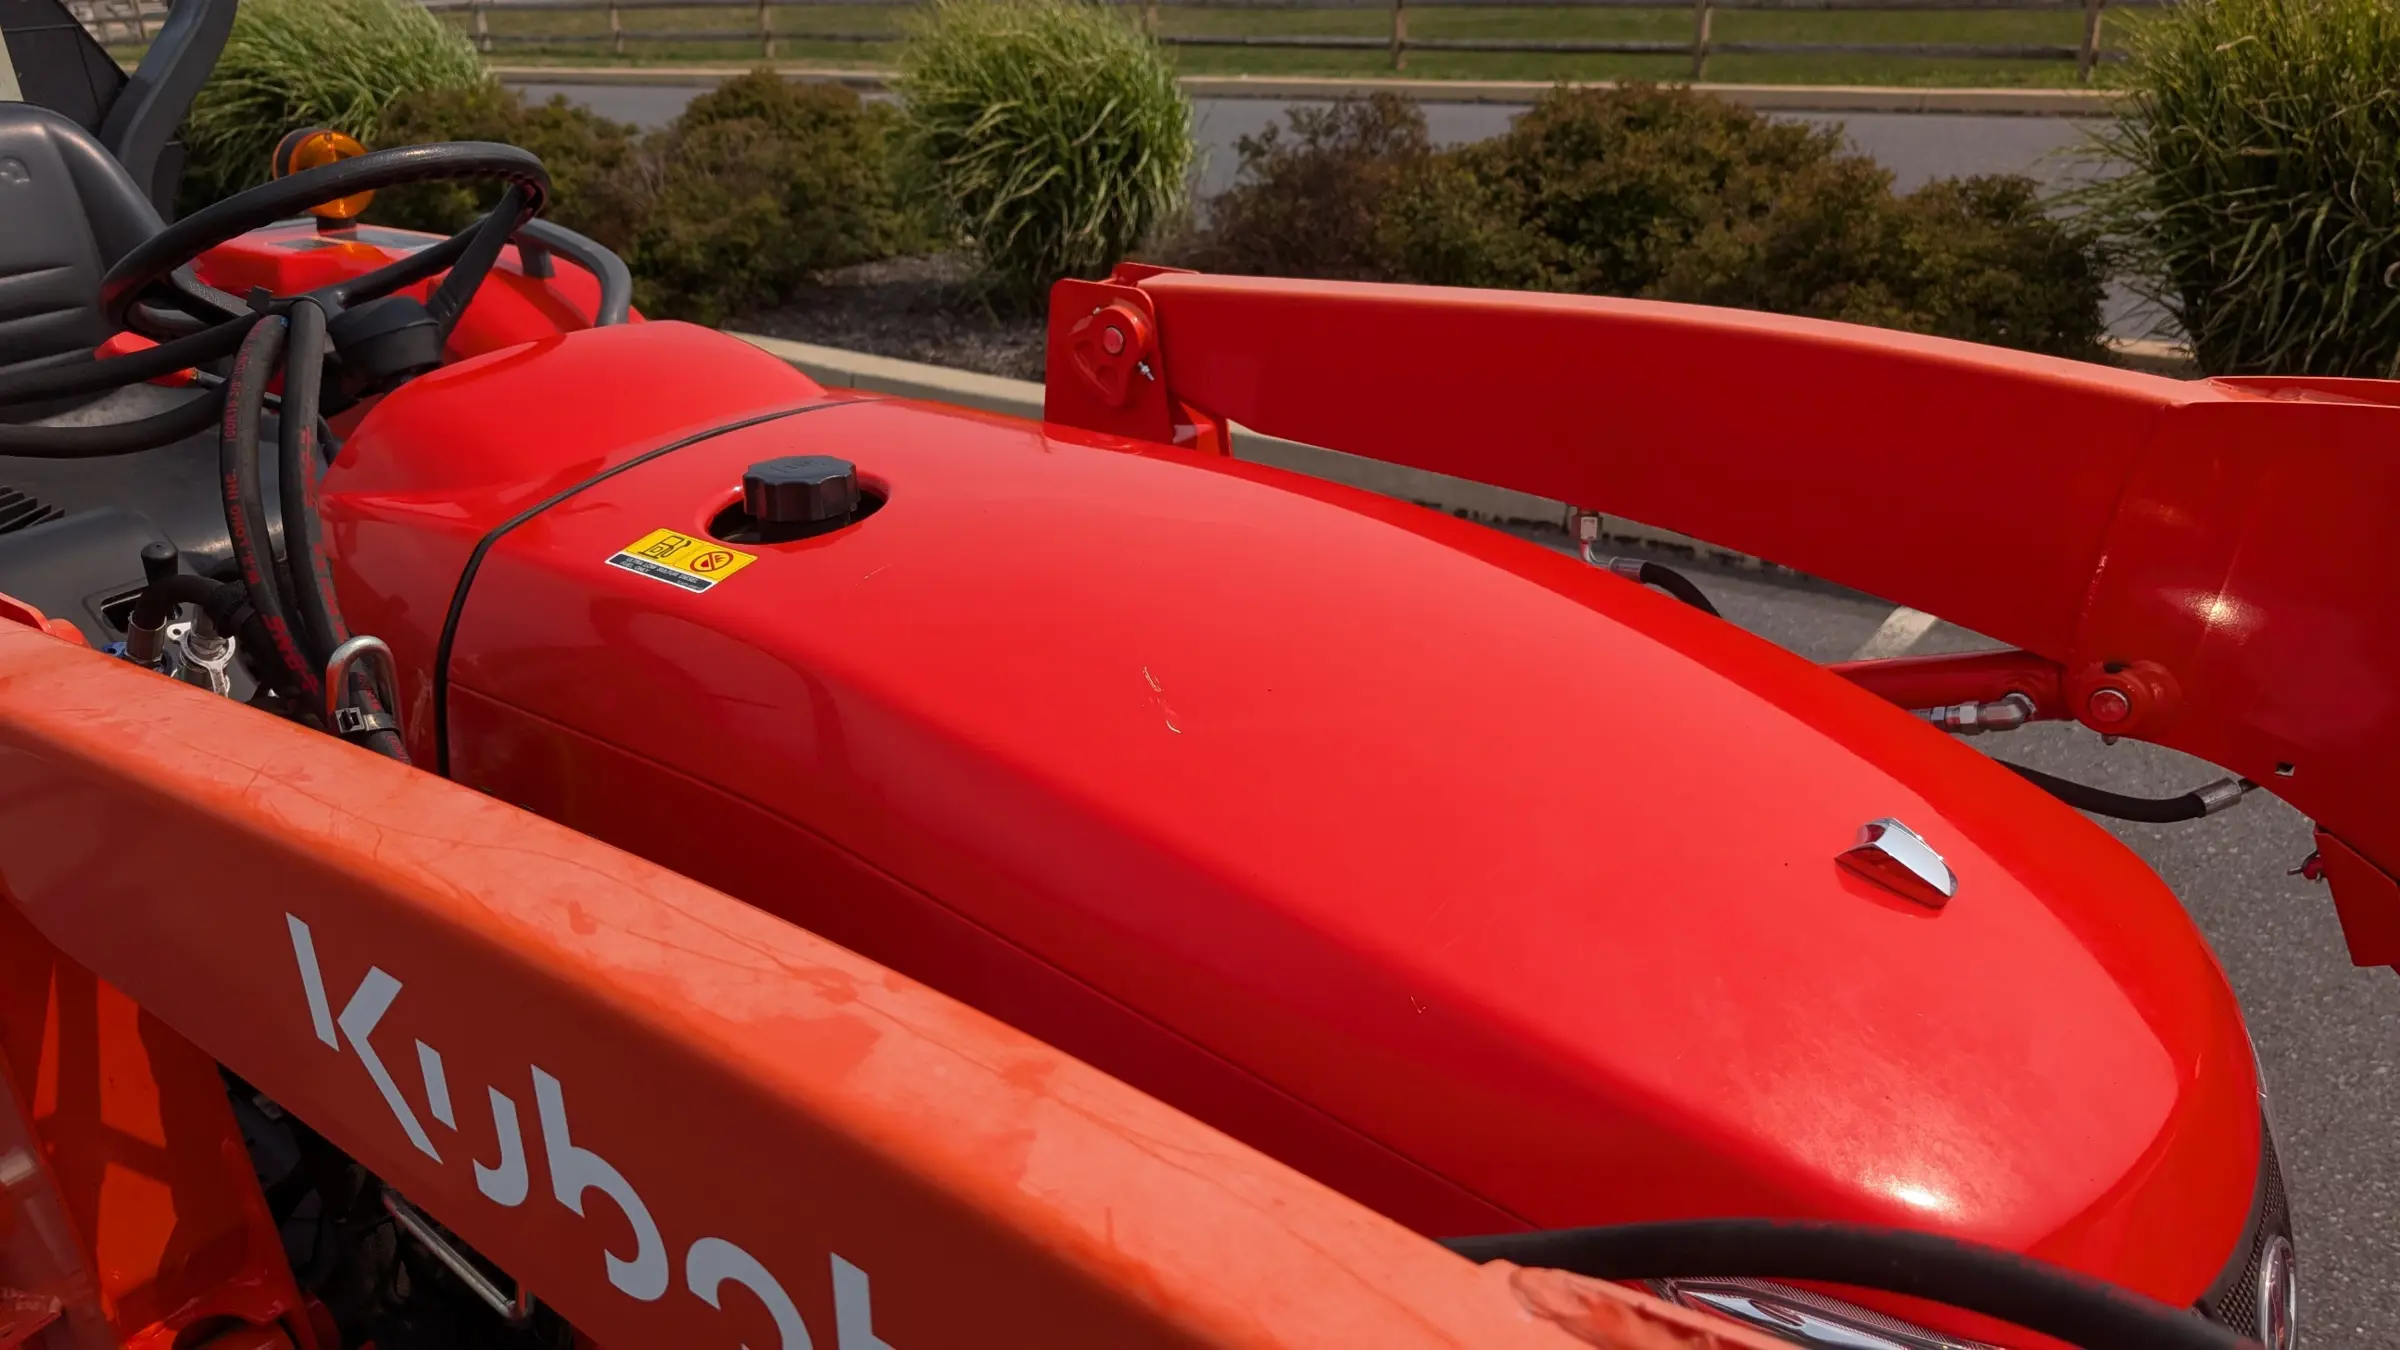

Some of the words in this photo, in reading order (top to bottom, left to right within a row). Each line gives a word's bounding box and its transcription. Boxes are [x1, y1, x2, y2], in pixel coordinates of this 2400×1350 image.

[620, 560, 633, 569] FUEL
[634, 564, 650, 573] ONLY
[679, 573, 699, 583] DIESEL
